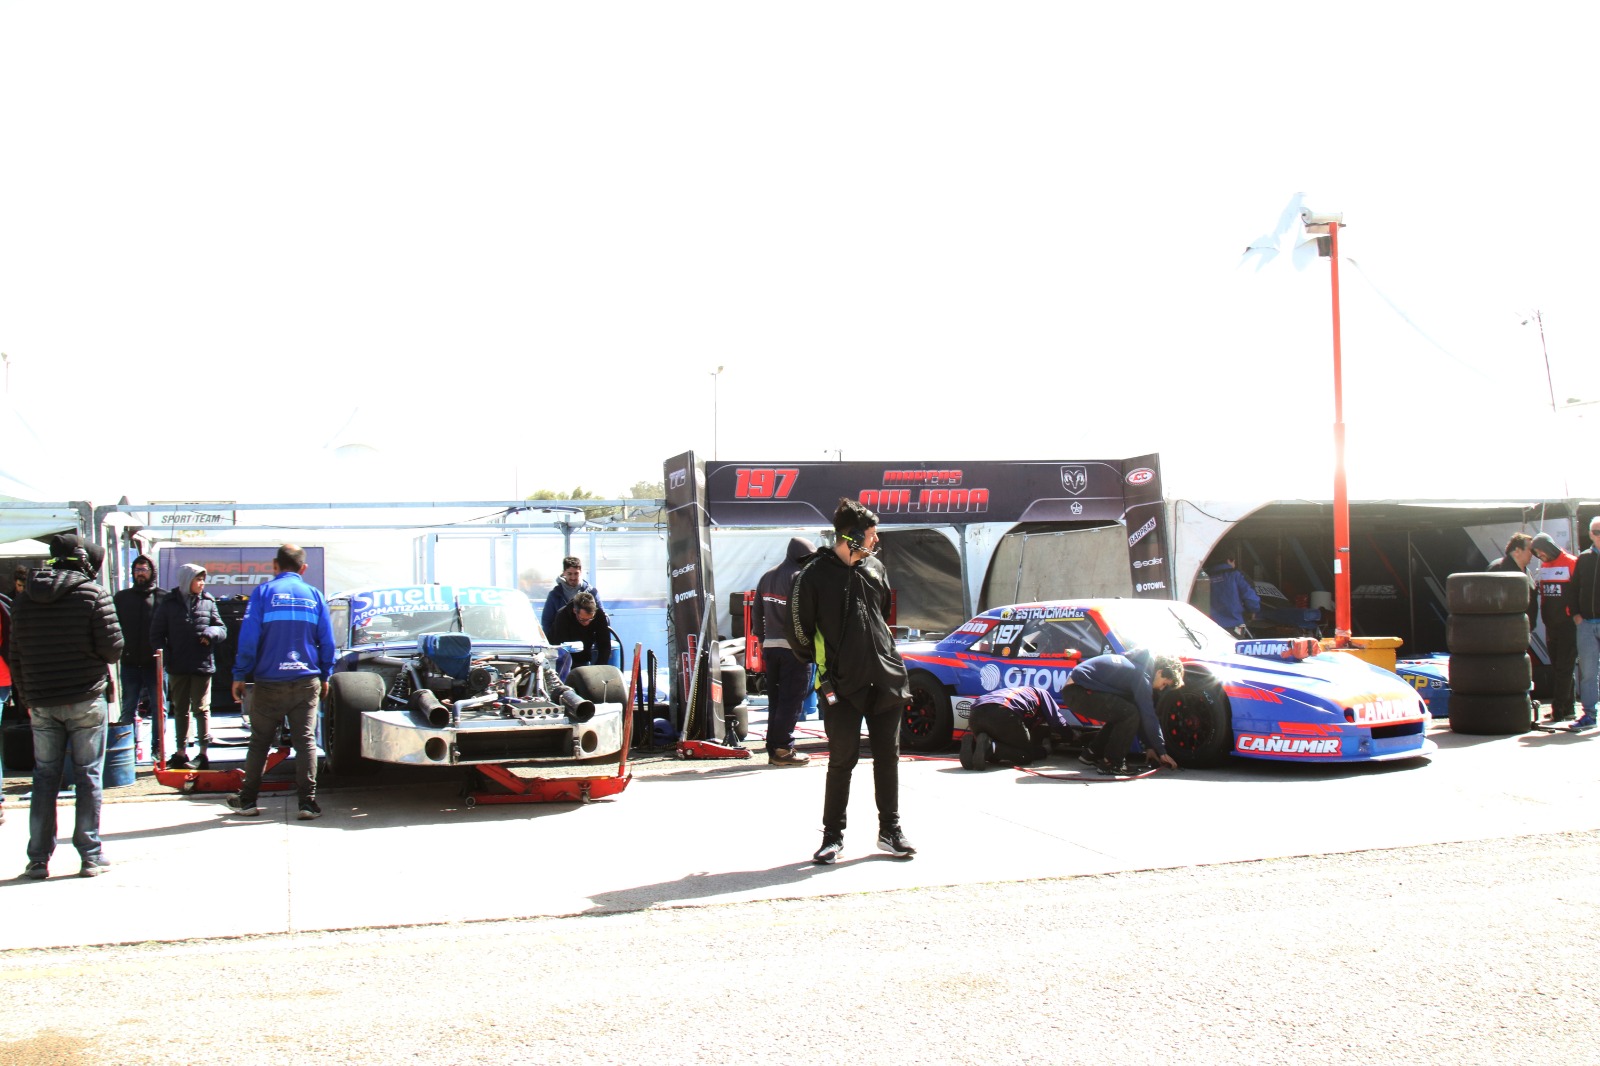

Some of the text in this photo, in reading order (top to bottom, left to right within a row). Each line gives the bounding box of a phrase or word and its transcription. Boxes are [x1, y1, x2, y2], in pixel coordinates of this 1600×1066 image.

[735, 469, 799, 498] 197
[883, 470, 963, 487] MARCOS
[161, 514, 221, 524] SPORT TEAM
[1142, 582, 1165, 591] OTOWIL
[353, 584, 442, 612] Smell
[353, 603, 450, 623] AROMATIZANTES
[995, 624, 1024, 644] 197
[1004, 667, 1072, 693] OTOW
